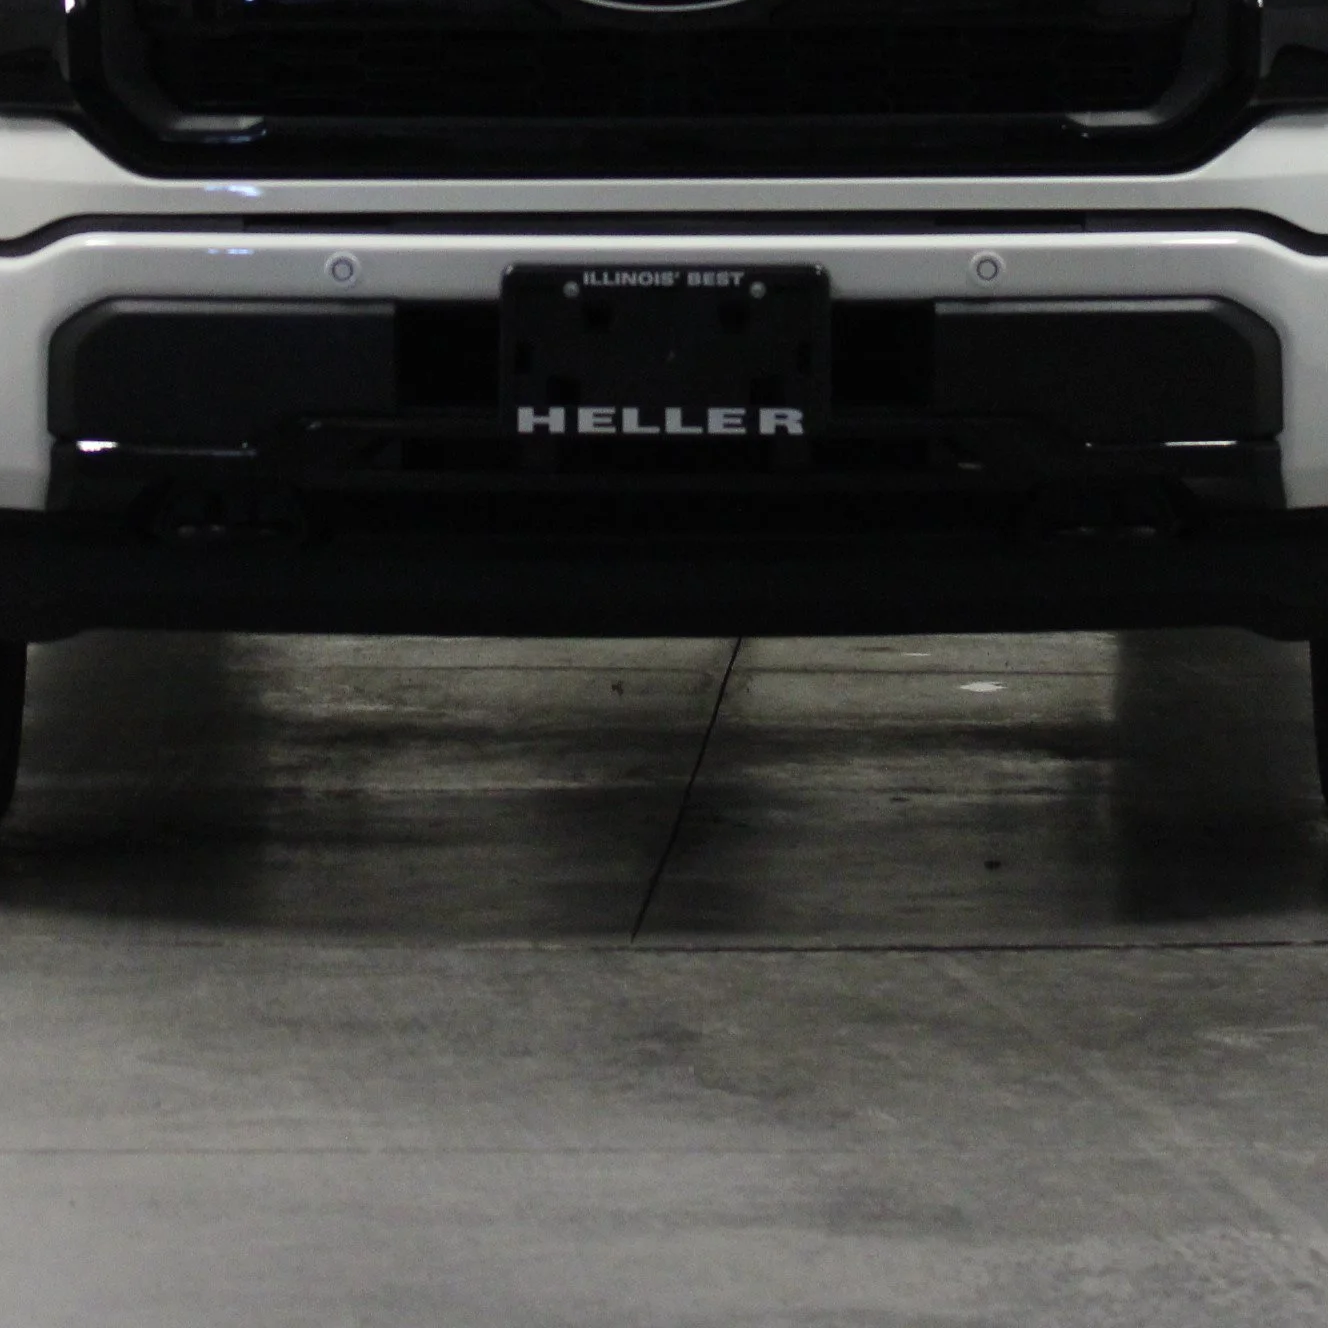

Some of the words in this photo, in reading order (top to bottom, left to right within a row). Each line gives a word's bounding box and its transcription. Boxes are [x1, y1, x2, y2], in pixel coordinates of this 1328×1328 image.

[583, 271, 681, 287] ILLINOIS'
[687, 271, 745, 287] BEST
[517, 406, 804, 435] HELLER
